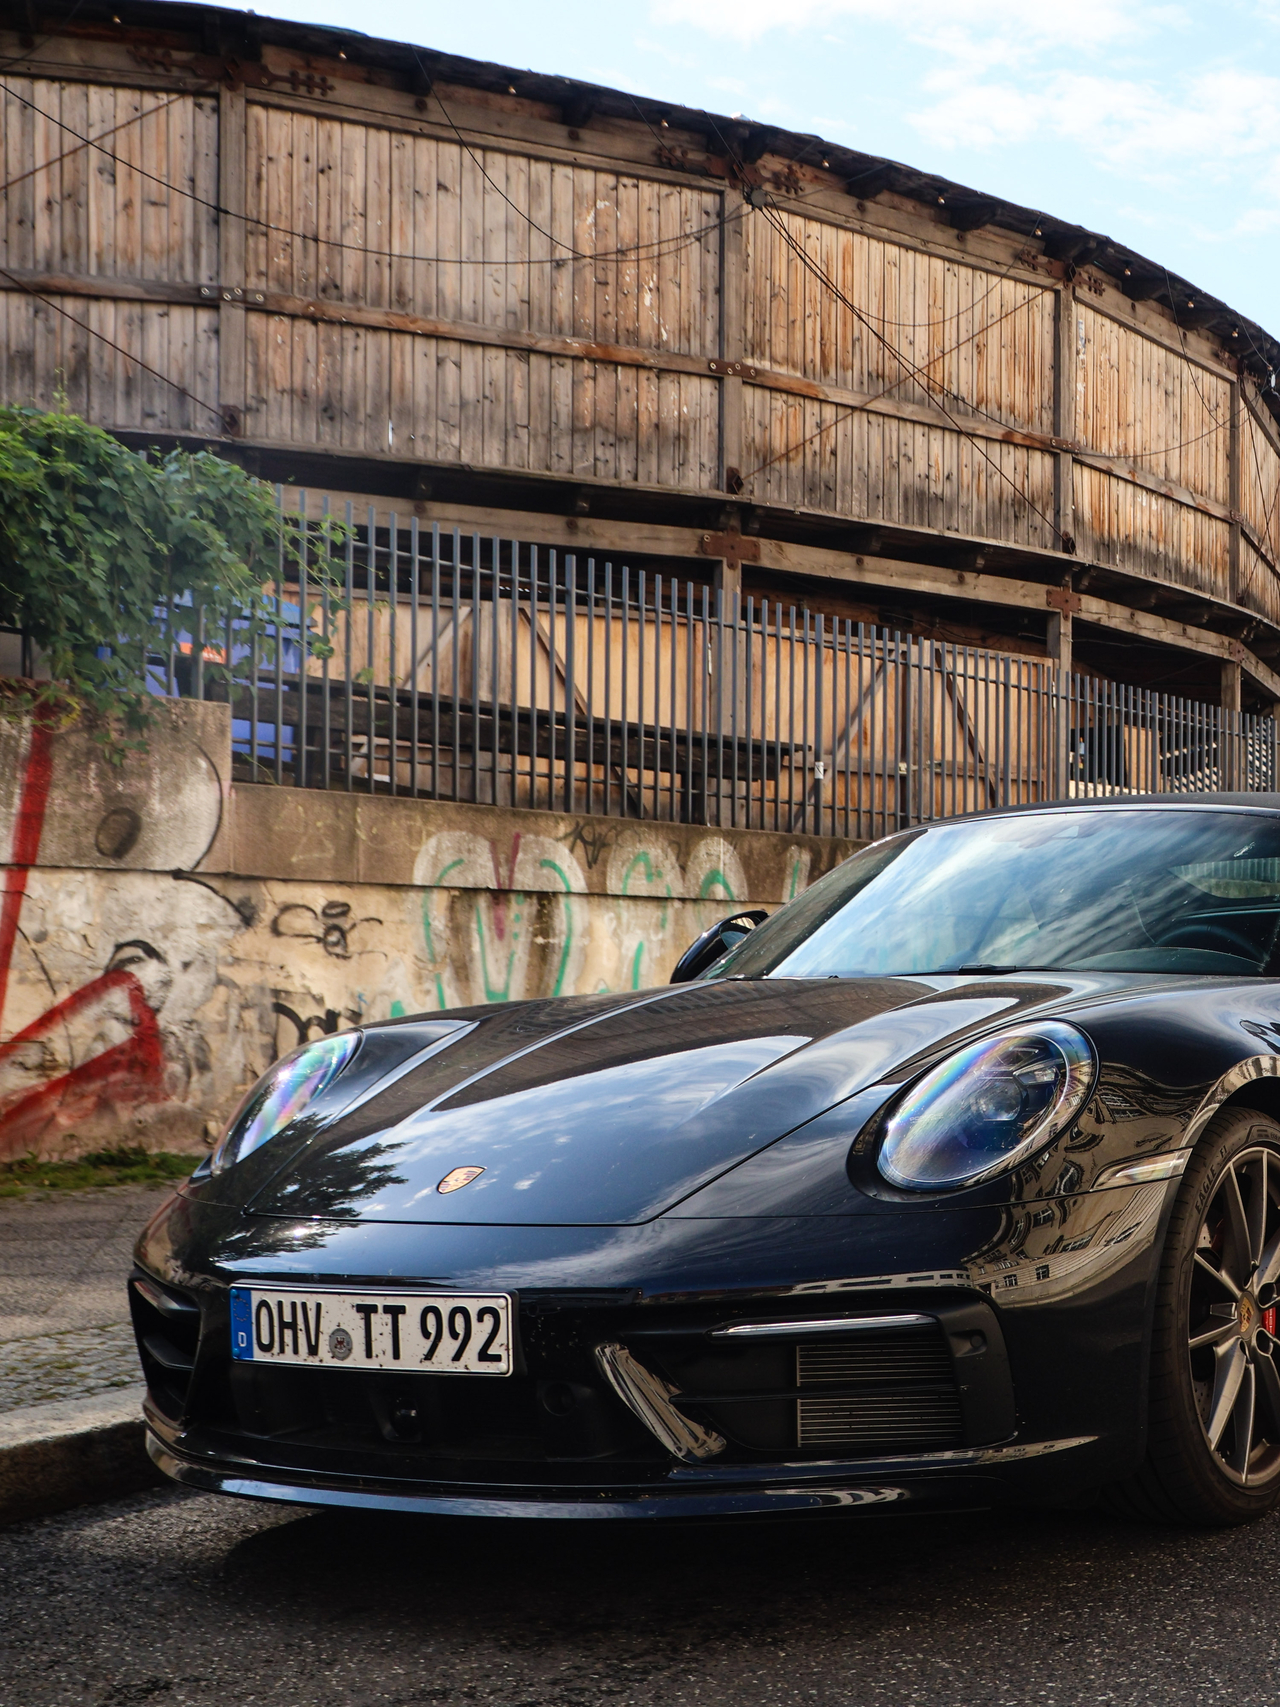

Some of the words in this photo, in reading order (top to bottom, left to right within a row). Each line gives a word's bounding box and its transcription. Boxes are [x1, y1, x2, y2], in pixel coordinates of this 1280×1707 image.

[1195, 1164, 1217, 1215] EAGLE
[237, 1332, 247, 1347] D
[255, 1299, 322, 1356] OHV
[355, 1303, 406, 1360] TT
[420, 1304, 503, 1362] 992
